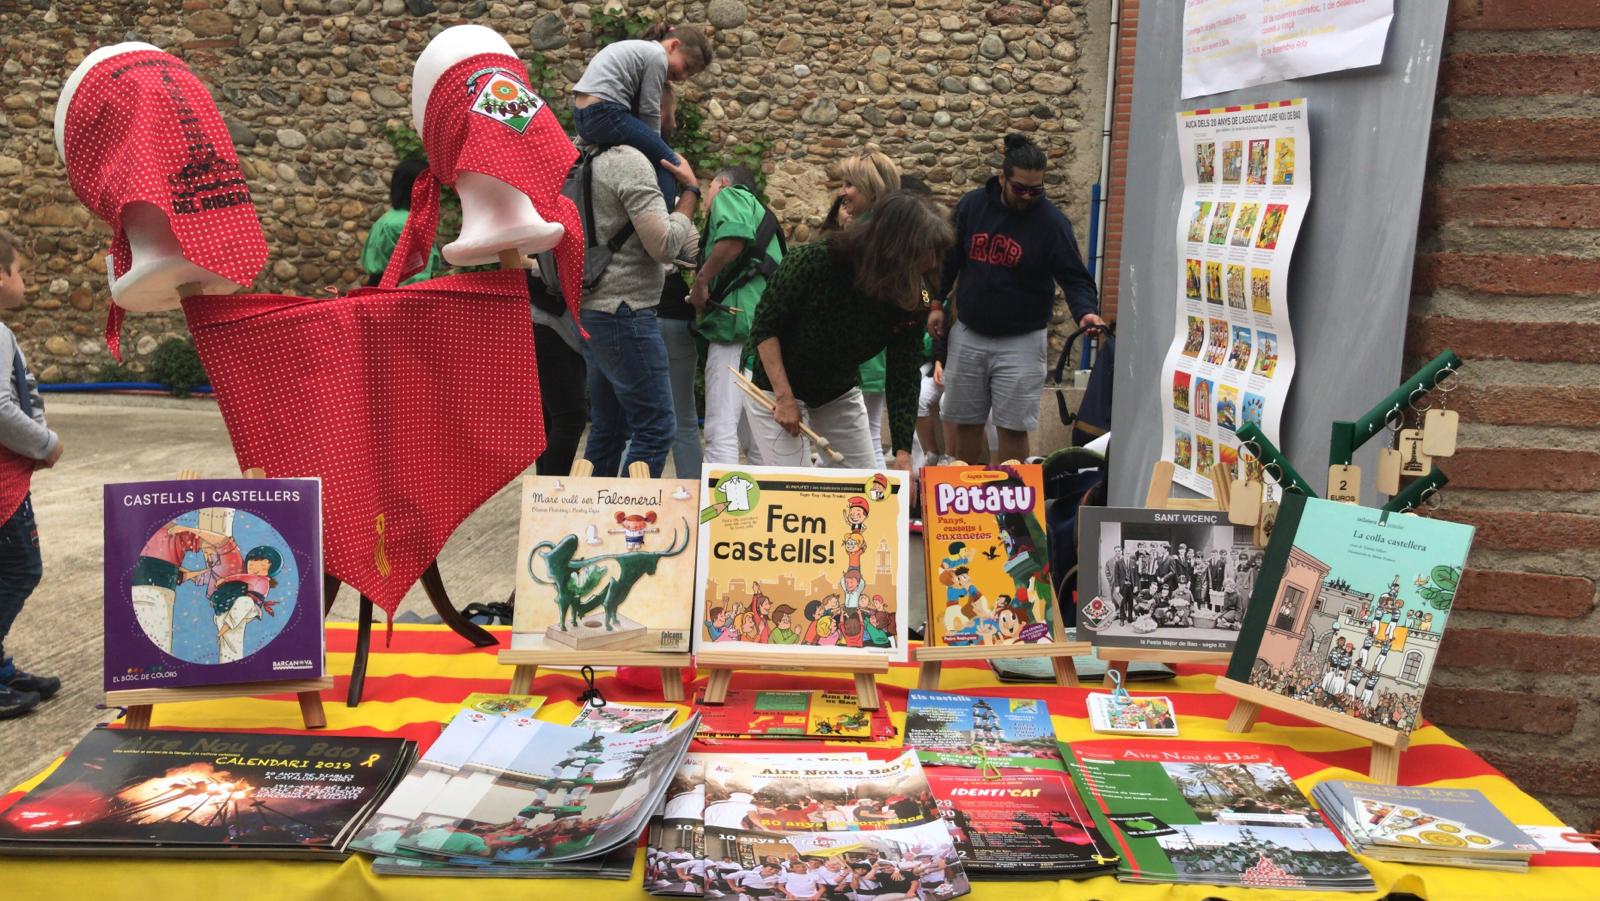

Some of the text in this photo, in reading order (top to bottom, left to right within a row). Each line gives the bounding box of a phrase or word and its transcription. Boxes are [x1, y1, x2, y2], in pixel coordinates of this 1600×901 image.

[1185, 120, 1197, 129] AUCA
[1197, 119, 1210, 128] DELS
[1210, 118, 1217, 127] 20
[1217, 117, 1231, 126] ANYS
[1231, 116, 1239, 125] DE
[1339, 480, 1348, 491] 2
[123, 490, 301, 507] CASTELLS I CASTELLERS
[532, 492, 559, 504] Mare
[561, 495, 579, 504] vull
[596, 488, 663, 506] Falconera!
[1330, 494, 1356, 502] EUROS
[766, 504, 826, 535] Fem
[1154, 513, 1218, 524] SANT VICENÇ
[936, 532, 992, 540] enxanetes
[1353, 529, 1364, 539] La
[1365, 533, 1385, 543] colla
[1387, 539, 1427, 552] castellera
[713, 538, 835, 565] castells!
[272, 659, 313, 668] BARCANOVA
[121, 674, 140, 682] BOSC
[140, 673, 150, 681] DE
[150, 671, 178, 679] COLORS
[215, 757, 352, 770] CALENDARI 2019
[868, 764, 901, 775] Bao
[785, 820, 824, 829] anys
[718, 833, 736, 841] 10
[740, 836, 776, 844] anys
